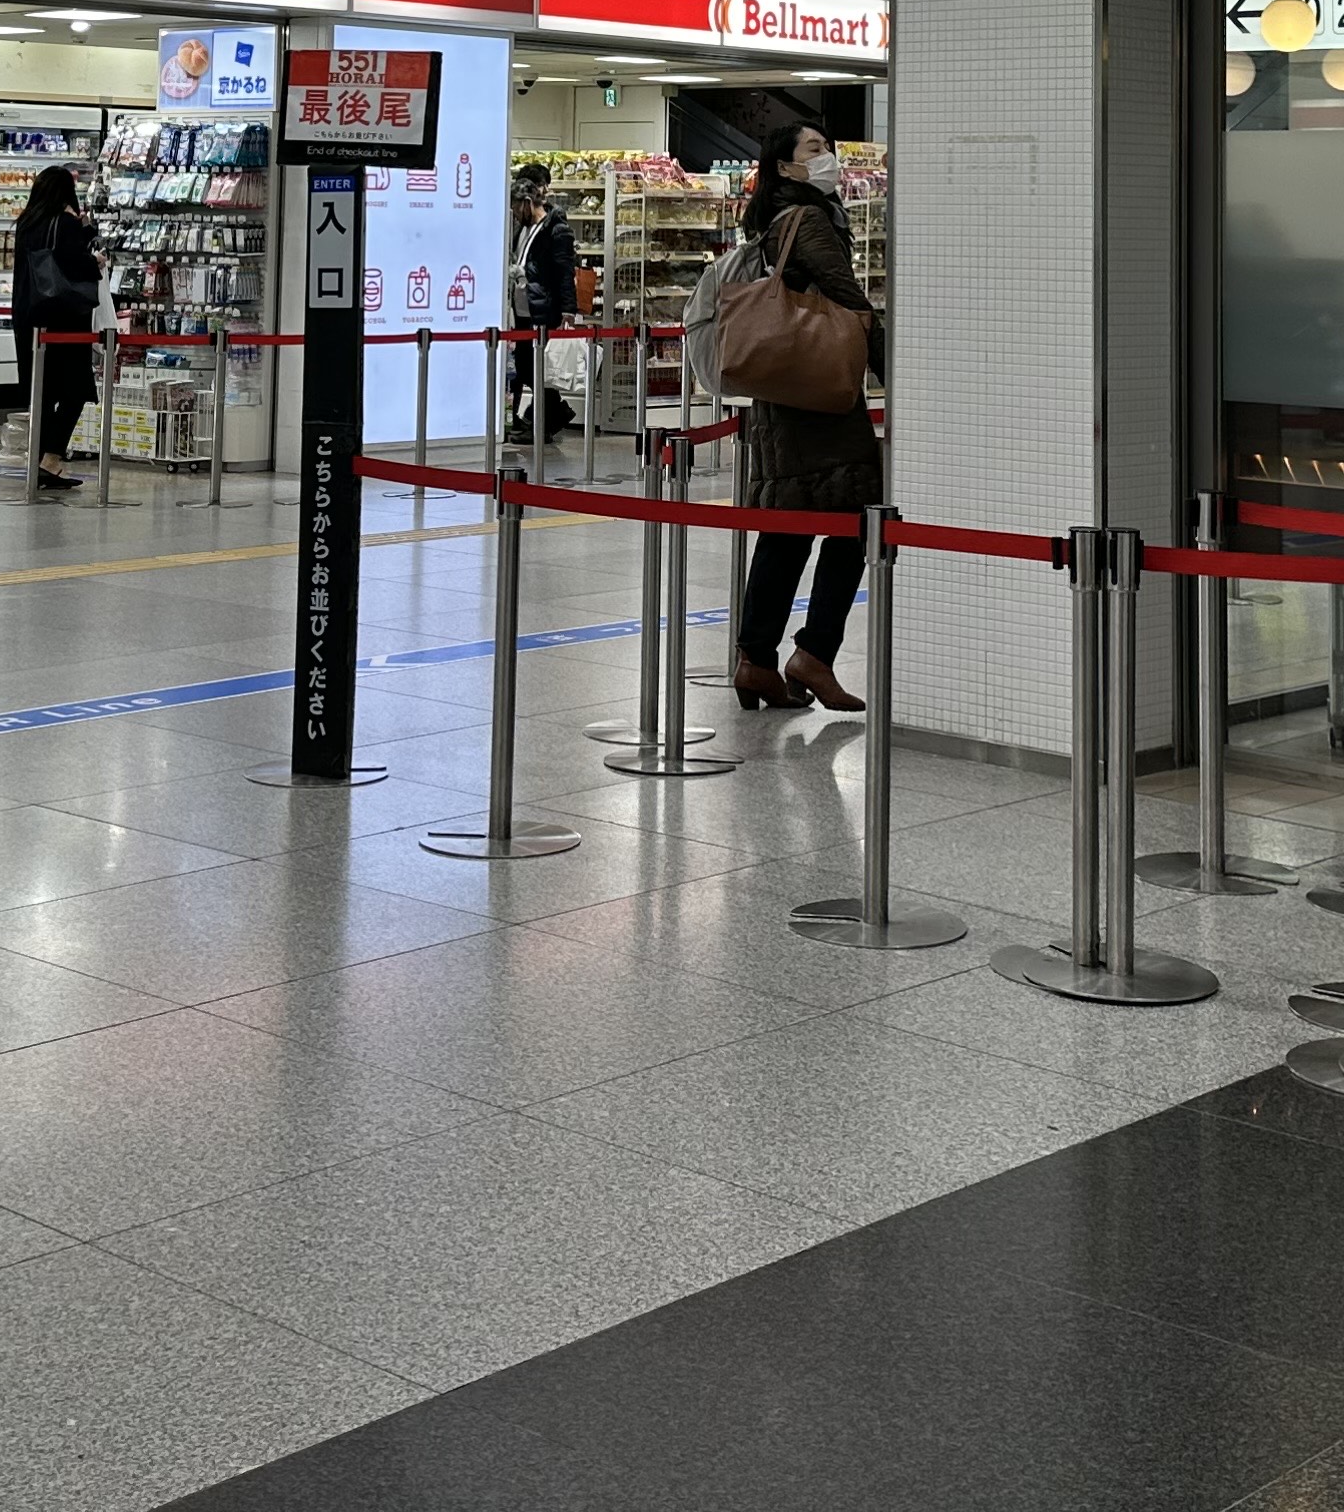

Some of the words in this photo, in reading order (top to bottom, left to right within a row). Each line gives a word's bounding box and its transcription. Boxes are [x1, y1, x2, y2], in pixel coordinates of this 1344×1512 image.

[337, 50, 378, 73] 551
[218, 75, 267, 95] 京かるね
[329, 71, 386, 85] HORAI
[299, 89, 413, 128] 最後尾
[306, 144, 324, 155] End
[325, 145, 336, 156] of
[336, 146, 380, 158] checkout
[313, 178, 351, 190] ENTER
[315, 201, 347, 299] 入口
[306, 435, 334, 741] こちらからお並びください
[41, 697, 163, 720] Line
